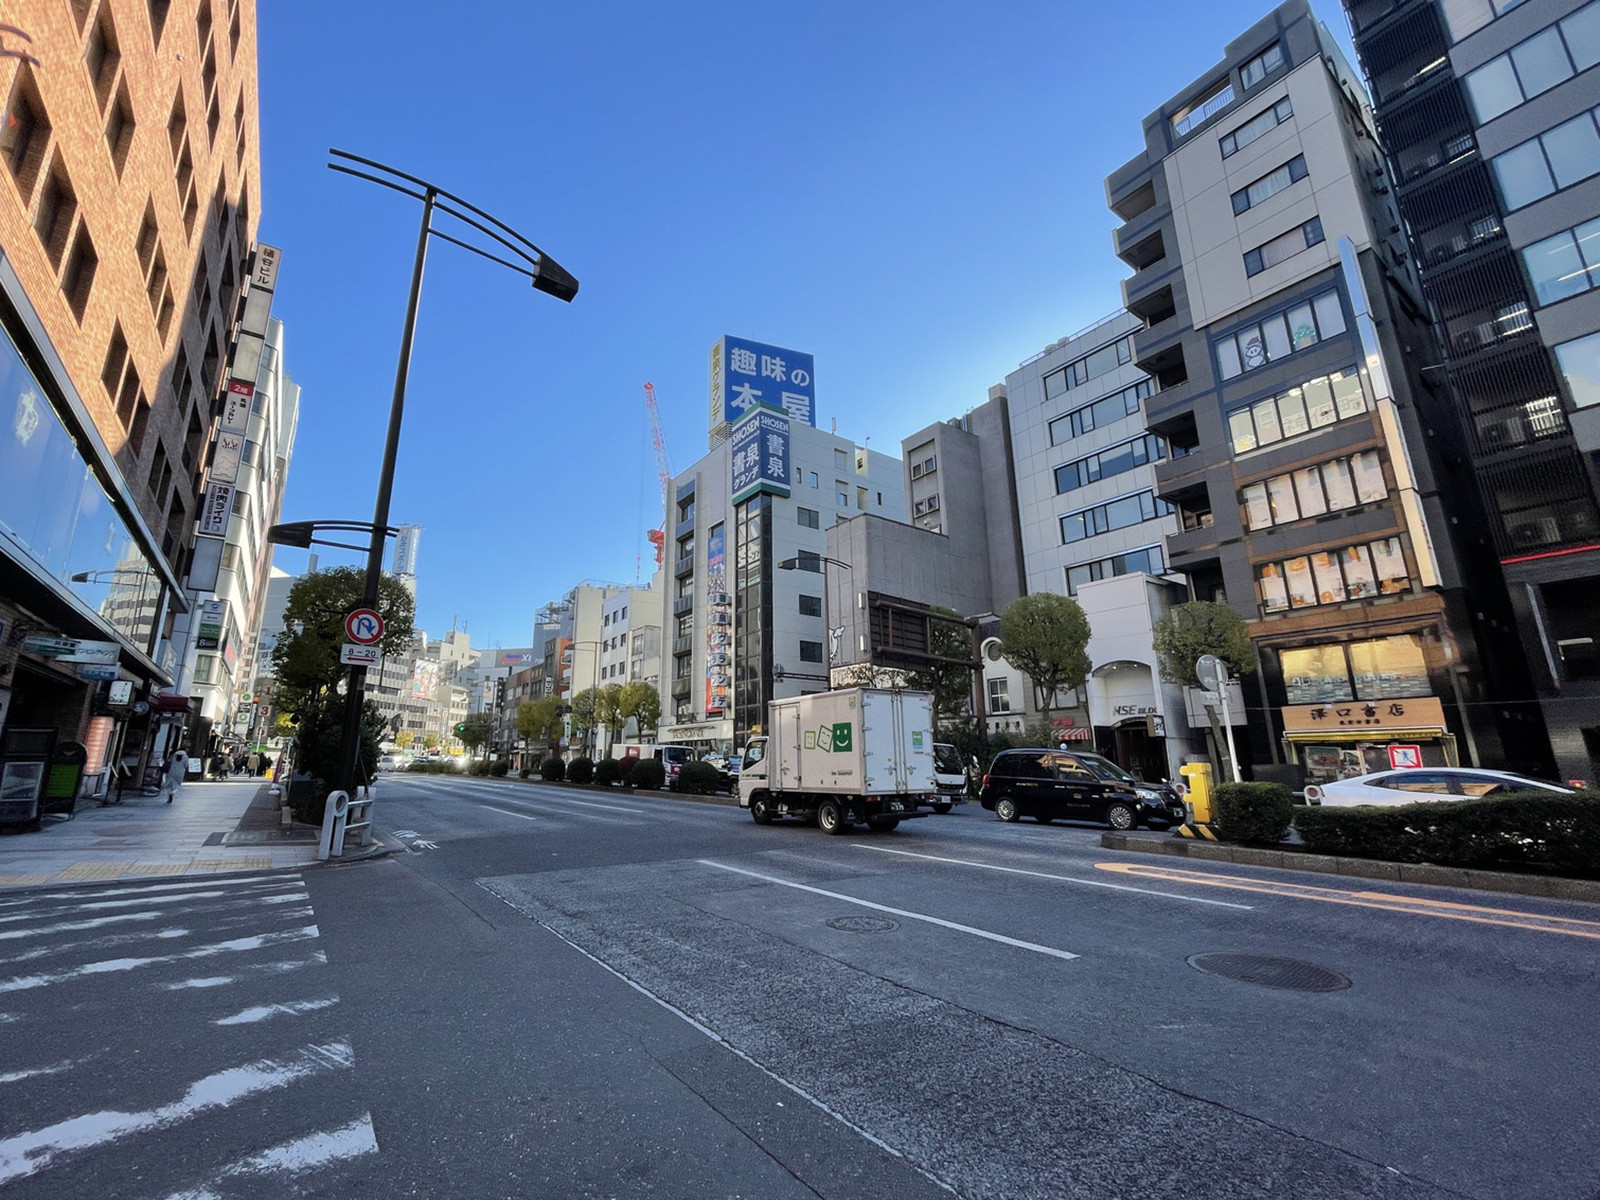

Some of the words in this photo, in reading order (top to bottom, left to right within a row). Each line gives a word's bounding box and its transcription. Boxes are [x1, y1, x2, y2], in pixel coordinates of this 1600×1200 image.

[730, 347, 810, 387] 趣味の
[730, 382, 811, 426] 本屋
[732, 416, 760, 446] SHOSEN
[760, 415, 789, 431] SHOSEN
[733, 442, 760, 477] 書泉
[766, 433, 785, 478] 書泉
[733, 464, 759, 490] グランデ
